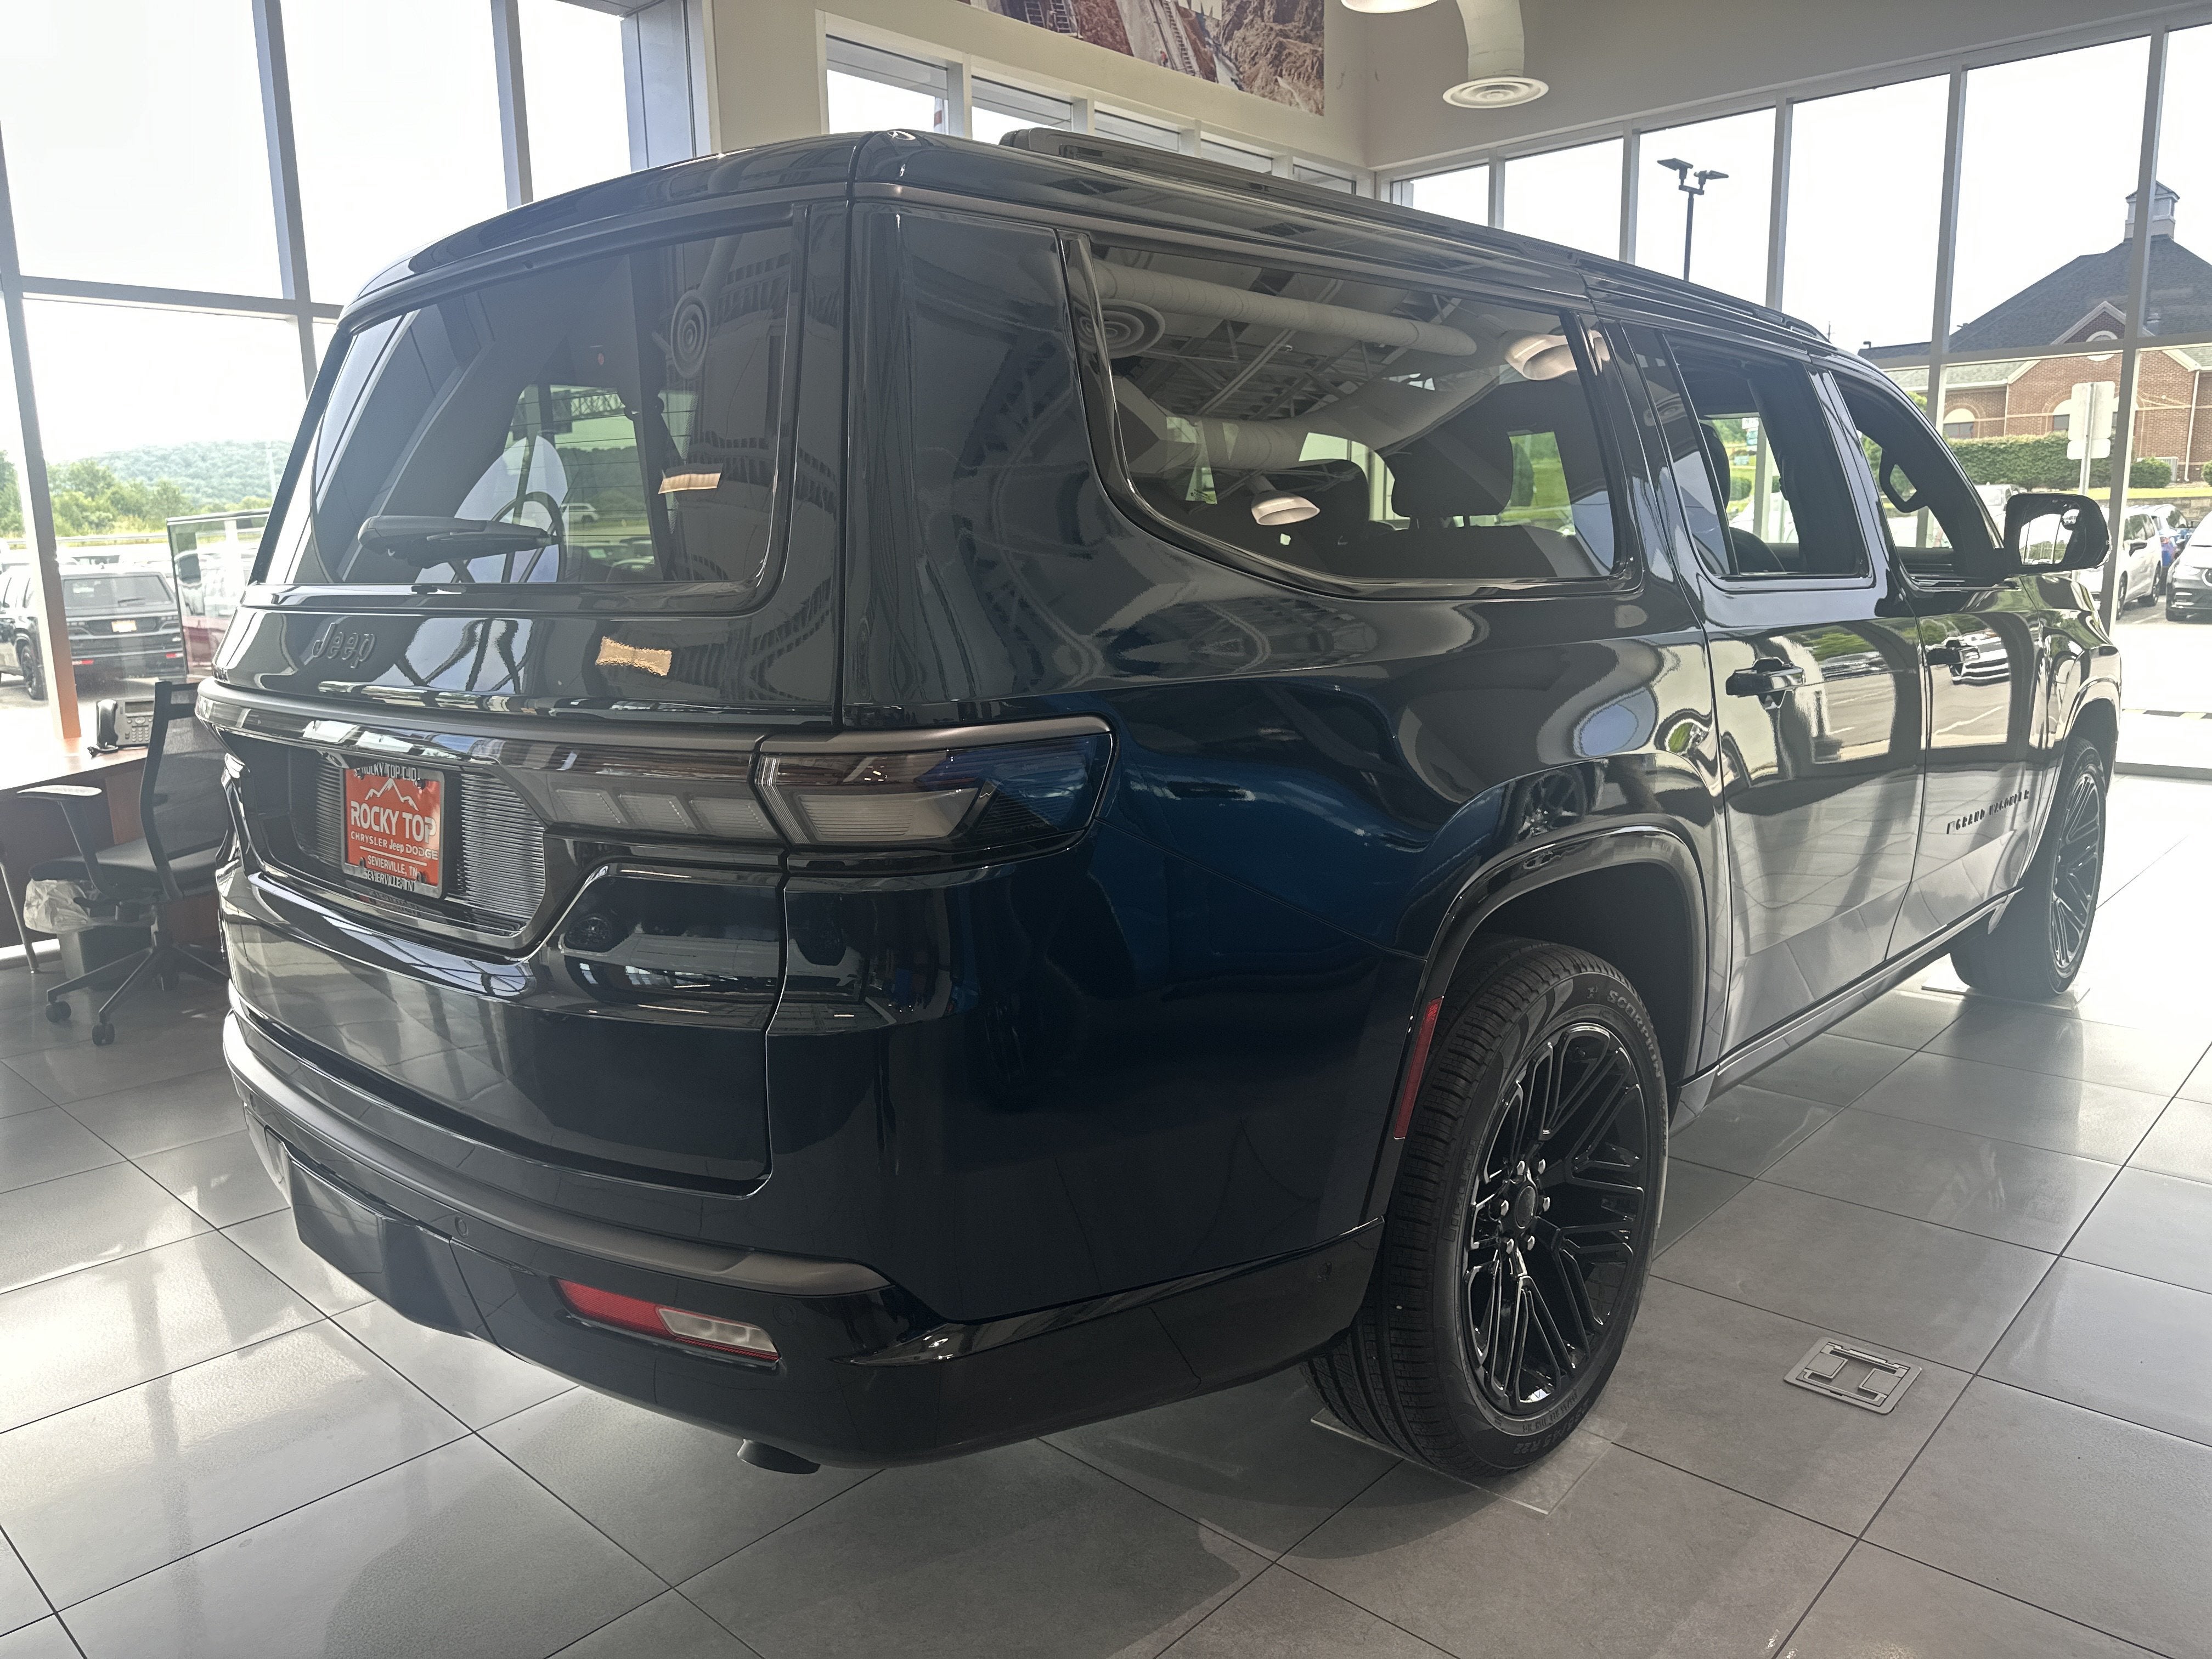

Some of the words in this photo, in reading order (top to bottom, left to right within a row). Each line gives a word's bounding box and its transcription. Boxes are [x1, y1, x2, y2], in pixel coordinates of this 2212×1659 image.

[312, 622, 375, 668] Jeep
[386, 763, 400, 778] TOP
[351, 800, 399, 836] ROCKY
[402, 811, 437, 844] TOP
[1956, 809, 1985, 830] GRAND
[351, 831, 388, 848] CHRYSLER
[389, 839, 404, 854] Jeep
[405, 844, 438, 860] DODGE
[368, 855, 407, 877] SEVIERVILLE,
[409, 866, 417, 878] TN
